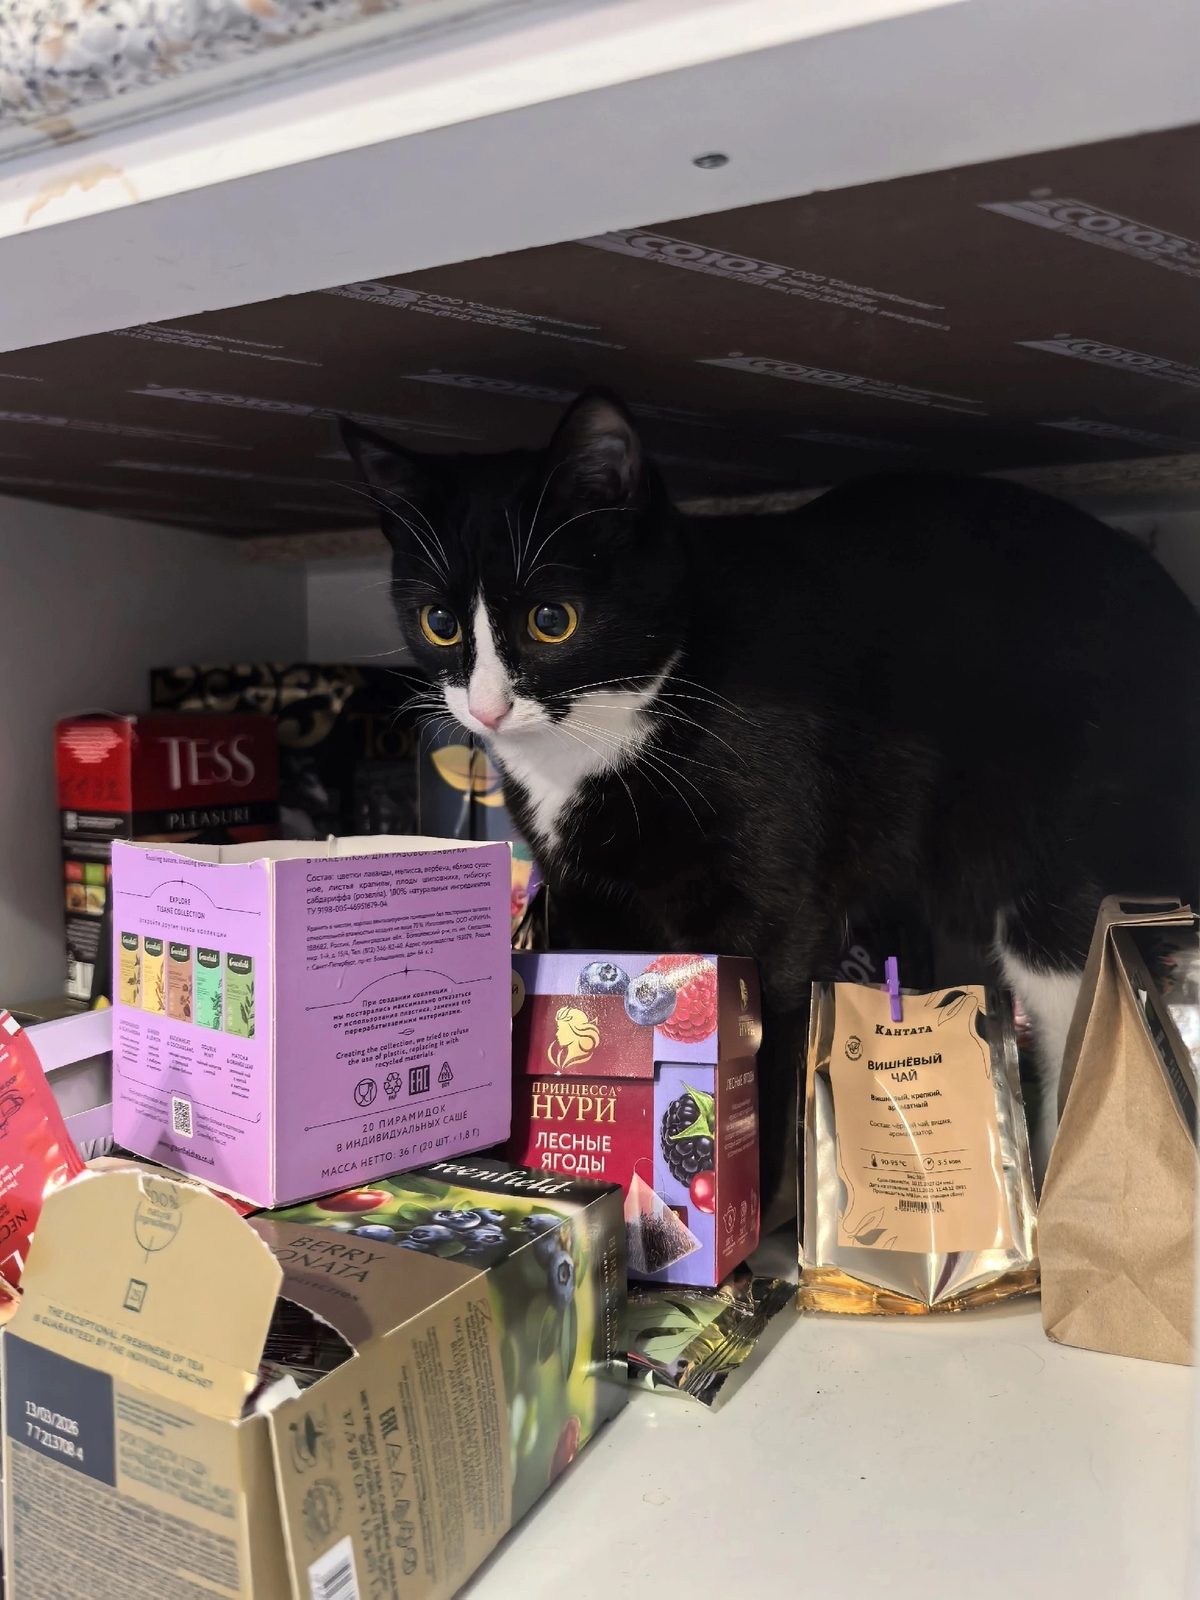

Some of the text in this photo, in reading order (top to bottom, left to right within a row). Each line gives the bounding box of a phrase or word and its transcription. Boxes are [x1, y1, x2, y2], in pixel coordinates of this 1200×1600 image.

[628, 236, 786, 280] СОЮЗ
[159, 735, 255, 791] TESS
[169, 895, 191, 906] EXPLORE
[409, 885, 448, 895] натуральных
[174, 908, 205, 919] COLLECTION
[346, 1006, 391, 1019] постарались
[392, 997, 437, 1010] максимально
[438, 991, 472, 1002] отказаться
[362, 988, 448, 1008] При создании коллекции
[344, 1012, 398, 1028] использования
[400, 1006, 433, 1017] пластика,
[461, 998, 471, 1007] его
[344, 1008, 463, 1036] перерабатываемыми материалами.
[336, 1048, 366, 1060] Creating
[366, 1045, 378, 1054] the
[380, 1038, 416, 1051] collection,
[426, 1032, 442, 1043] tried
[450, 1027, 470, 1036] refuse
[348, 1036, 460, 1066] the use of plastic, replacing it with
[375, 1057, 404, 1069] recycled
[891, 1069, 918, 1083] ЧАЙ
[532, 1082, 617, 1097] ПРИНЦЕССА
[911, 1090, 943, 1099] крепкий,
[363, 1104, 447, 1133] 20 ПИРАМИДОК
[530, 1094, 617, 1123] НУРИ
[336, 1110, 468, 1152] В ИНДИВИДУАЛЬНЫХ САШЕ
[535, 1131, 612, 1153] ЛЕСНЫЕ
[321, 1161, 357, 1178] МАССА
[361, 1151, 395, 1168] НЕТТО:
[399, 1147, 409, 1158] 36
[412, 1145, 418, 1156] Г
[419, 1140, 433, 1154] (20
[459, 1129, 471, 1141] 1,8
[541, 1152, 605, 1174] ЯГОДЫ
[428, 1163, 575, 1194] reenfield
[0, 1209, 27, 1242] NEC
[271, 1246, 369, 1283] ONATA
[288, 1236, 387, 1265] BERRY
[42, 1316, 95, 1343] GUARANTEED
[96, 1337, 108, 1347] BY
[109, 1342, 126, 1355] THE
[177, 1368, 213, 1389] SACHET
[48, 1305, 204, 1373] THE EXCEPTIONAL FRESHNESS OF TEA
